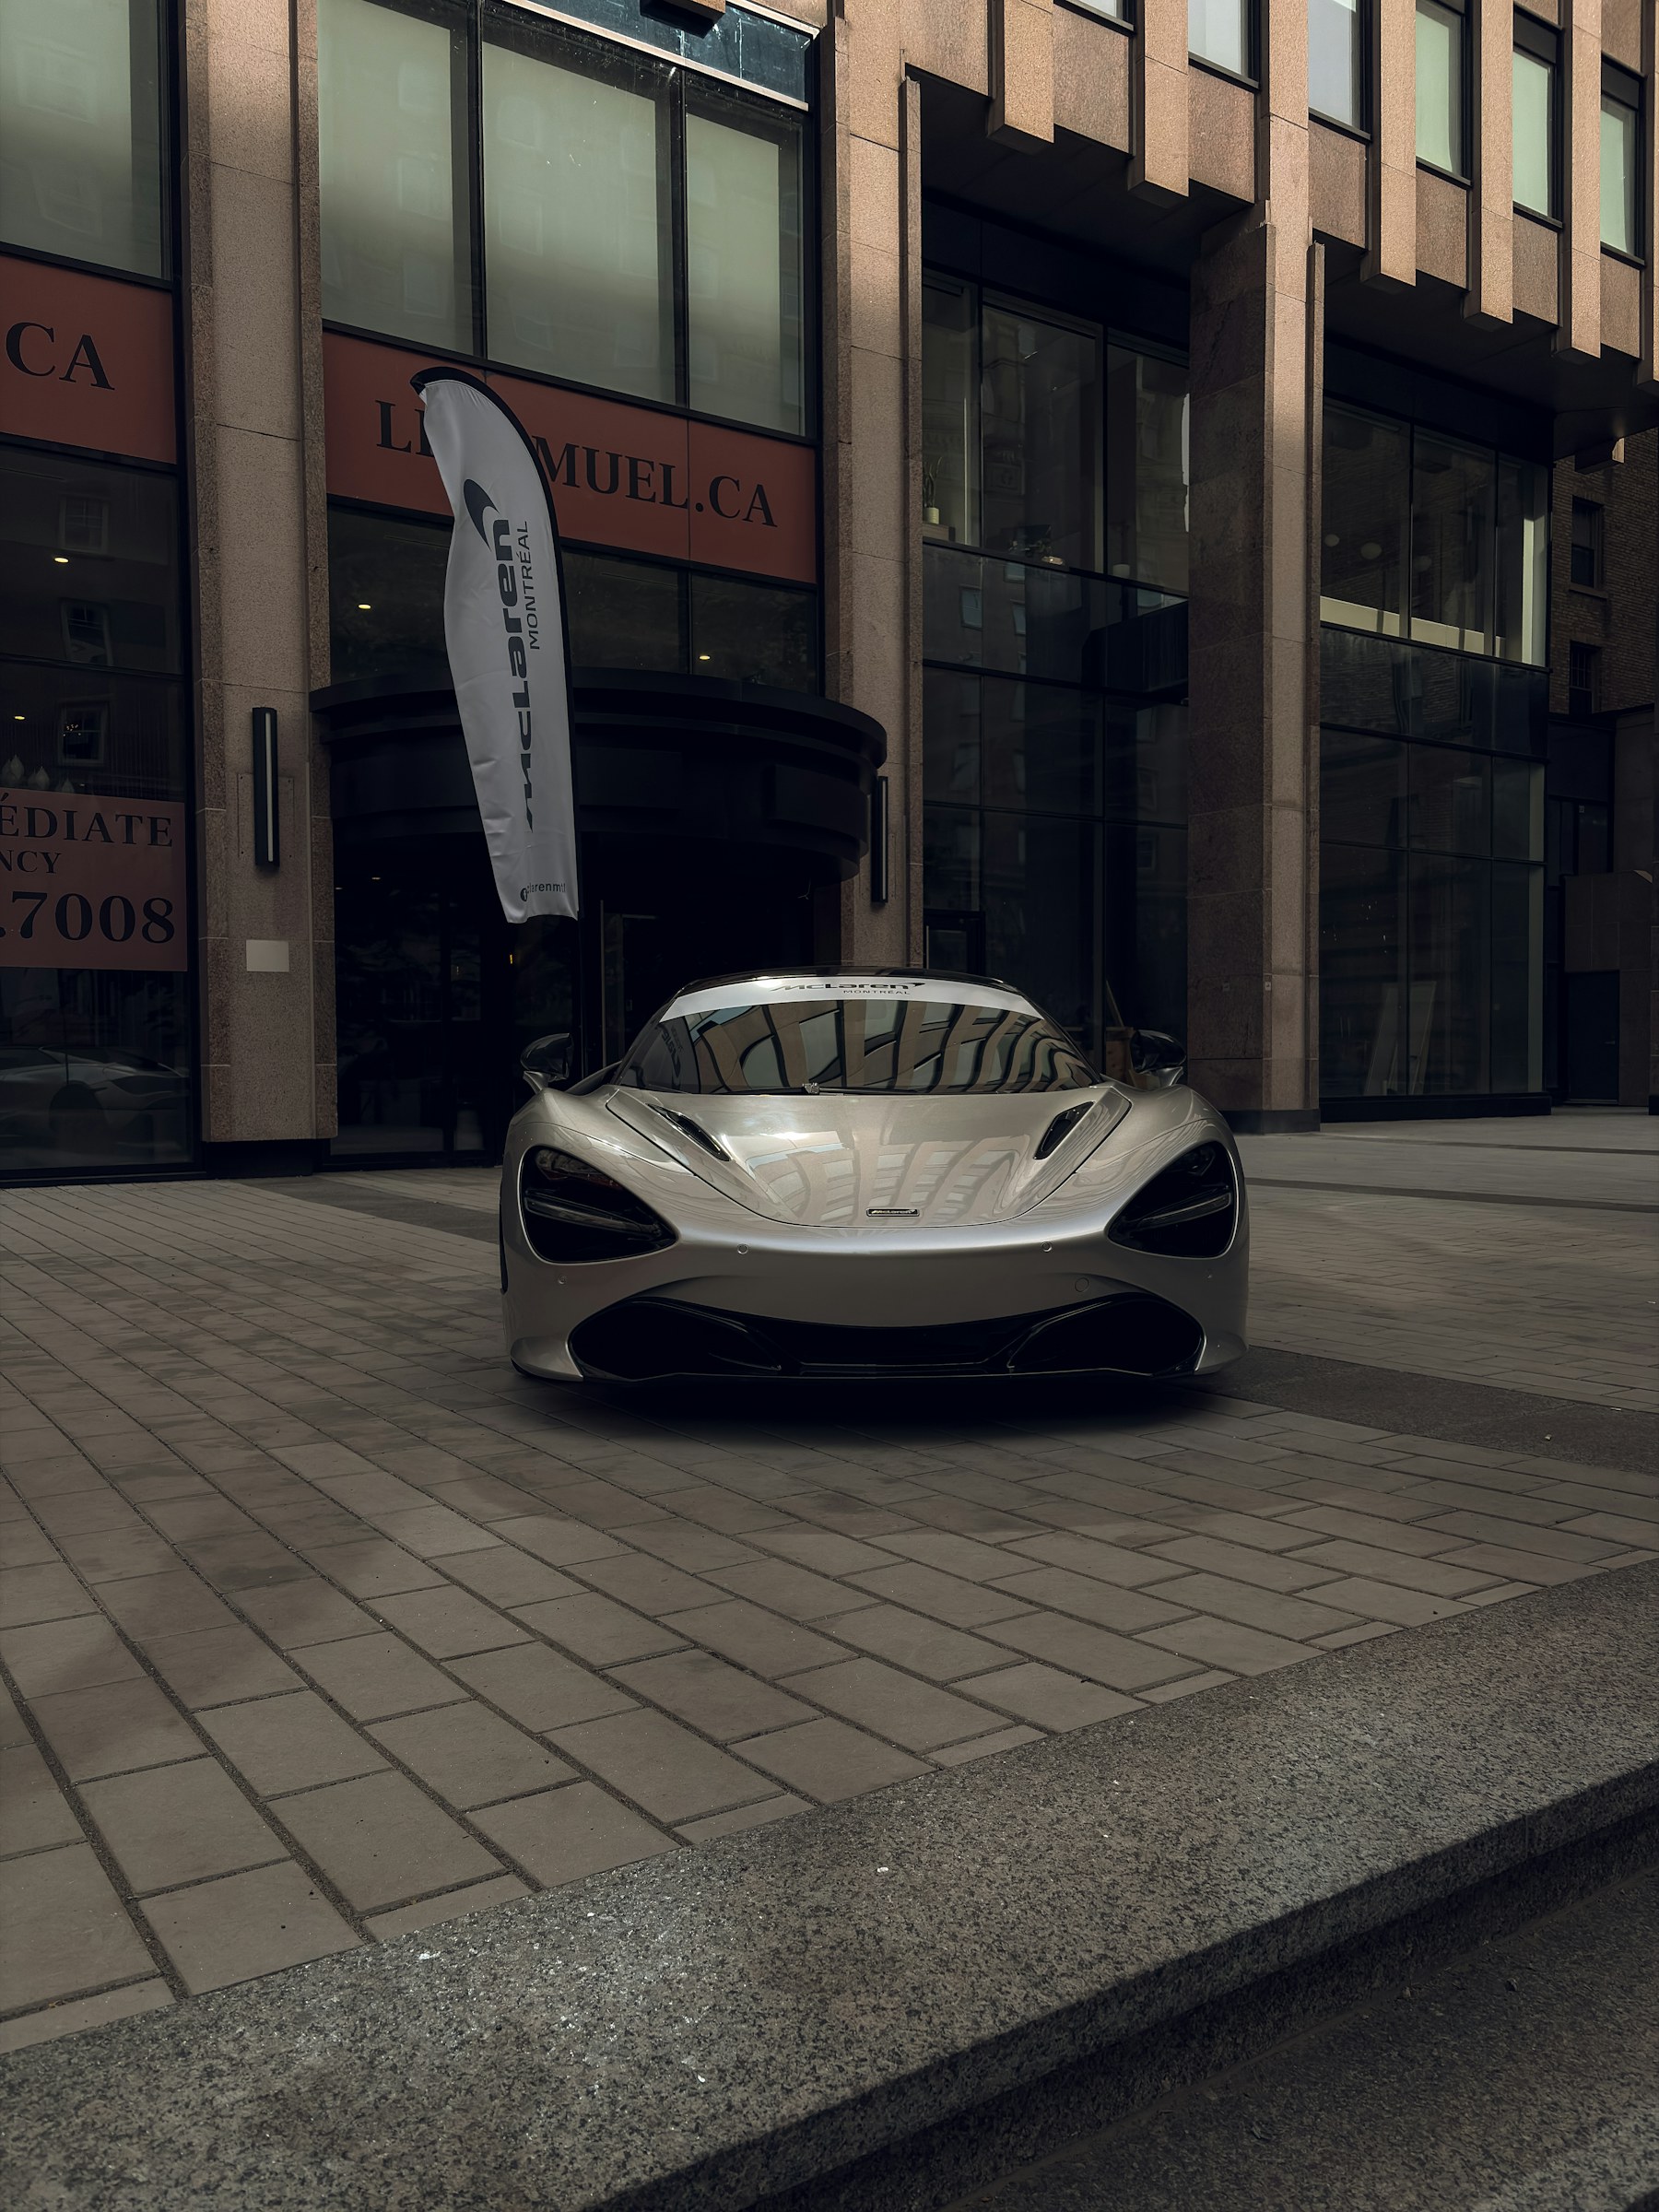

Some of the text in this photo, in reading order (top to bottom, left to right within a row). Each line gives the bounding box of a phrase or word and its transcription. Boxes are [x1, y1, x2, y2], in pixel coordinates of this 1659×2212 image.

[6, 323, 114, 390] CA
[515, 521, 540, 650] MONTRÉAL
[771, 982, 909, 992] McLaren
